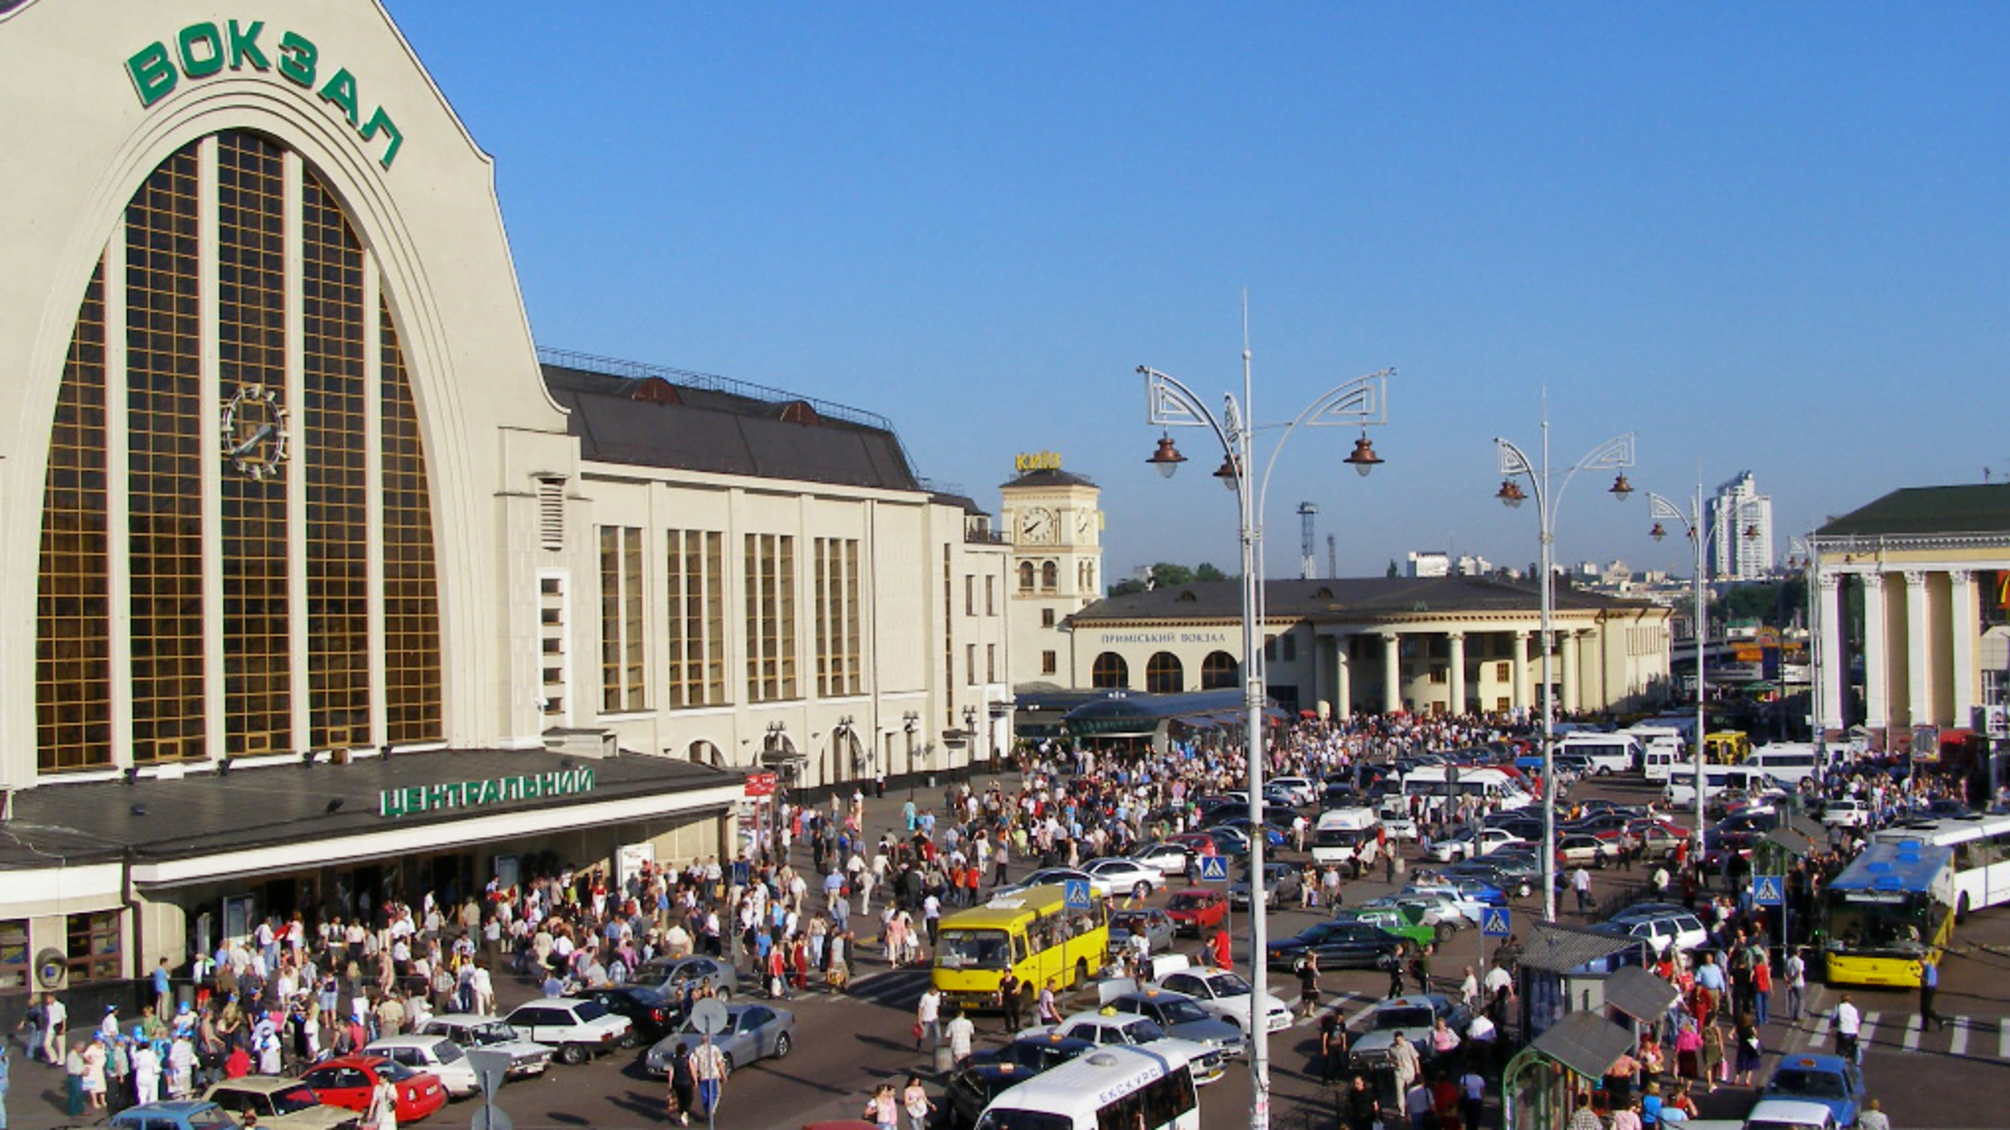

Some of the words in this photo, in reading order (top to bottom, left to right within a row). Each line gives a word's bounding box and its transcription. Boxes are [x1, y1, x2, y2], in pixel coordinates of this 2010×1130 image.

[124, 19, 403, 172] ВОКЗАЛ
[1015, 449, 1061, 471] КИЇВ
[380, 764, 595, 817] ЦЕНТРАЛЬНИЙ
